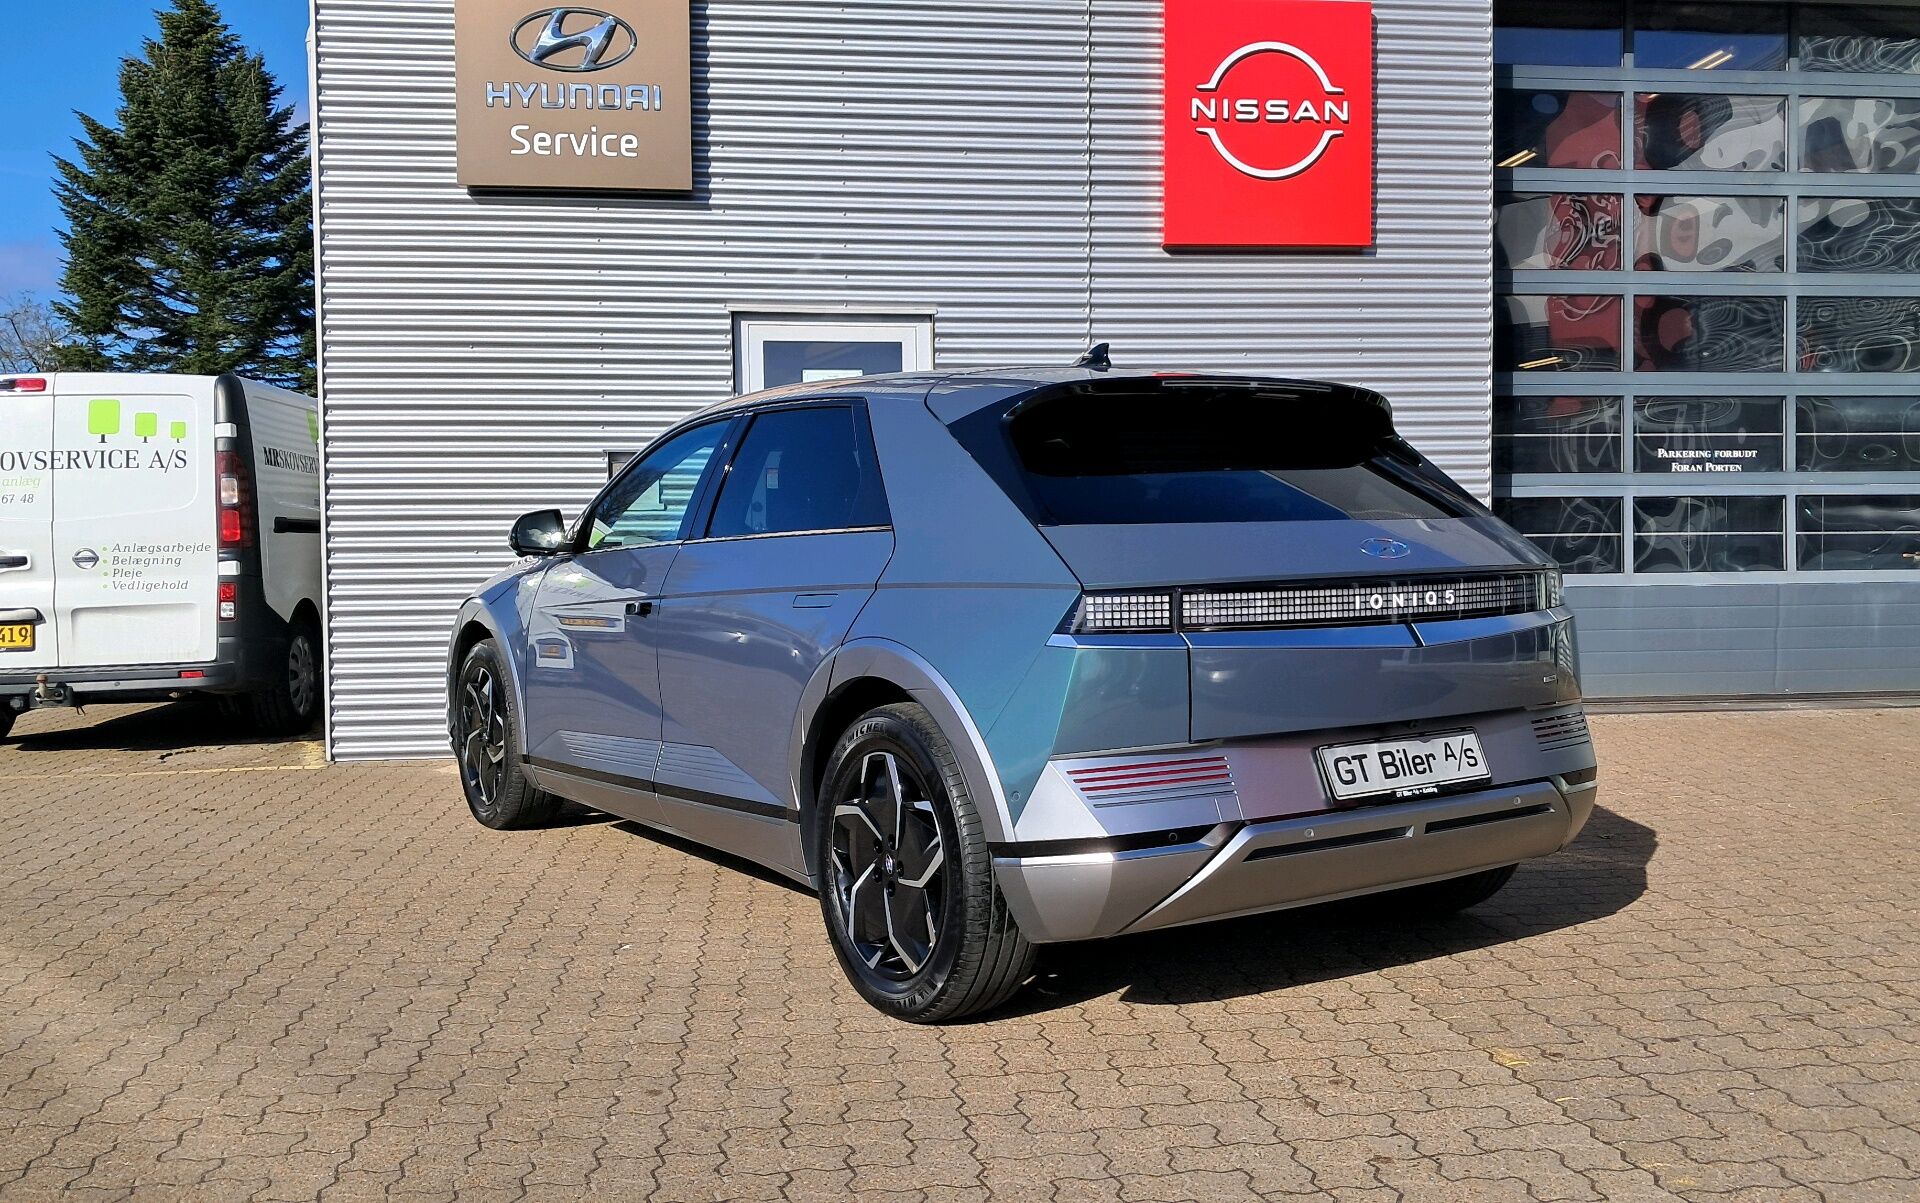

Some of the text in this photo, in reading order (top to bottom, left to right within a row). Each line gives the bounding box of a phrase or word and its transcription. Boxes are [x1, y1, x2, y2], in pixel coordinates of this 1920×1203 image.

[485, 81, 662, 111] HYUNDAI
[1190, 97, 1350, 124] NISSAN
[510, 124, 639, 158] Service
[1657, 448, 1758, 458] PARKERING FORBUDT
[0, 449, 188, 474] OVSERVICE A/S
[1671, 462, 1742, 472] FORAN PORTEN
[1, 476, 41, 488] anlæg
[19, 493, 35, 504] 48
[111, 543, 212, 554] Anlægsarbejde
[111, 555, 182, 567] Belægning
[112, 568, 143, 580] Pleje
[112, 580, 189, 593] Vedligehold
[1333, 738, 1479, 786] GT Biler A/S
